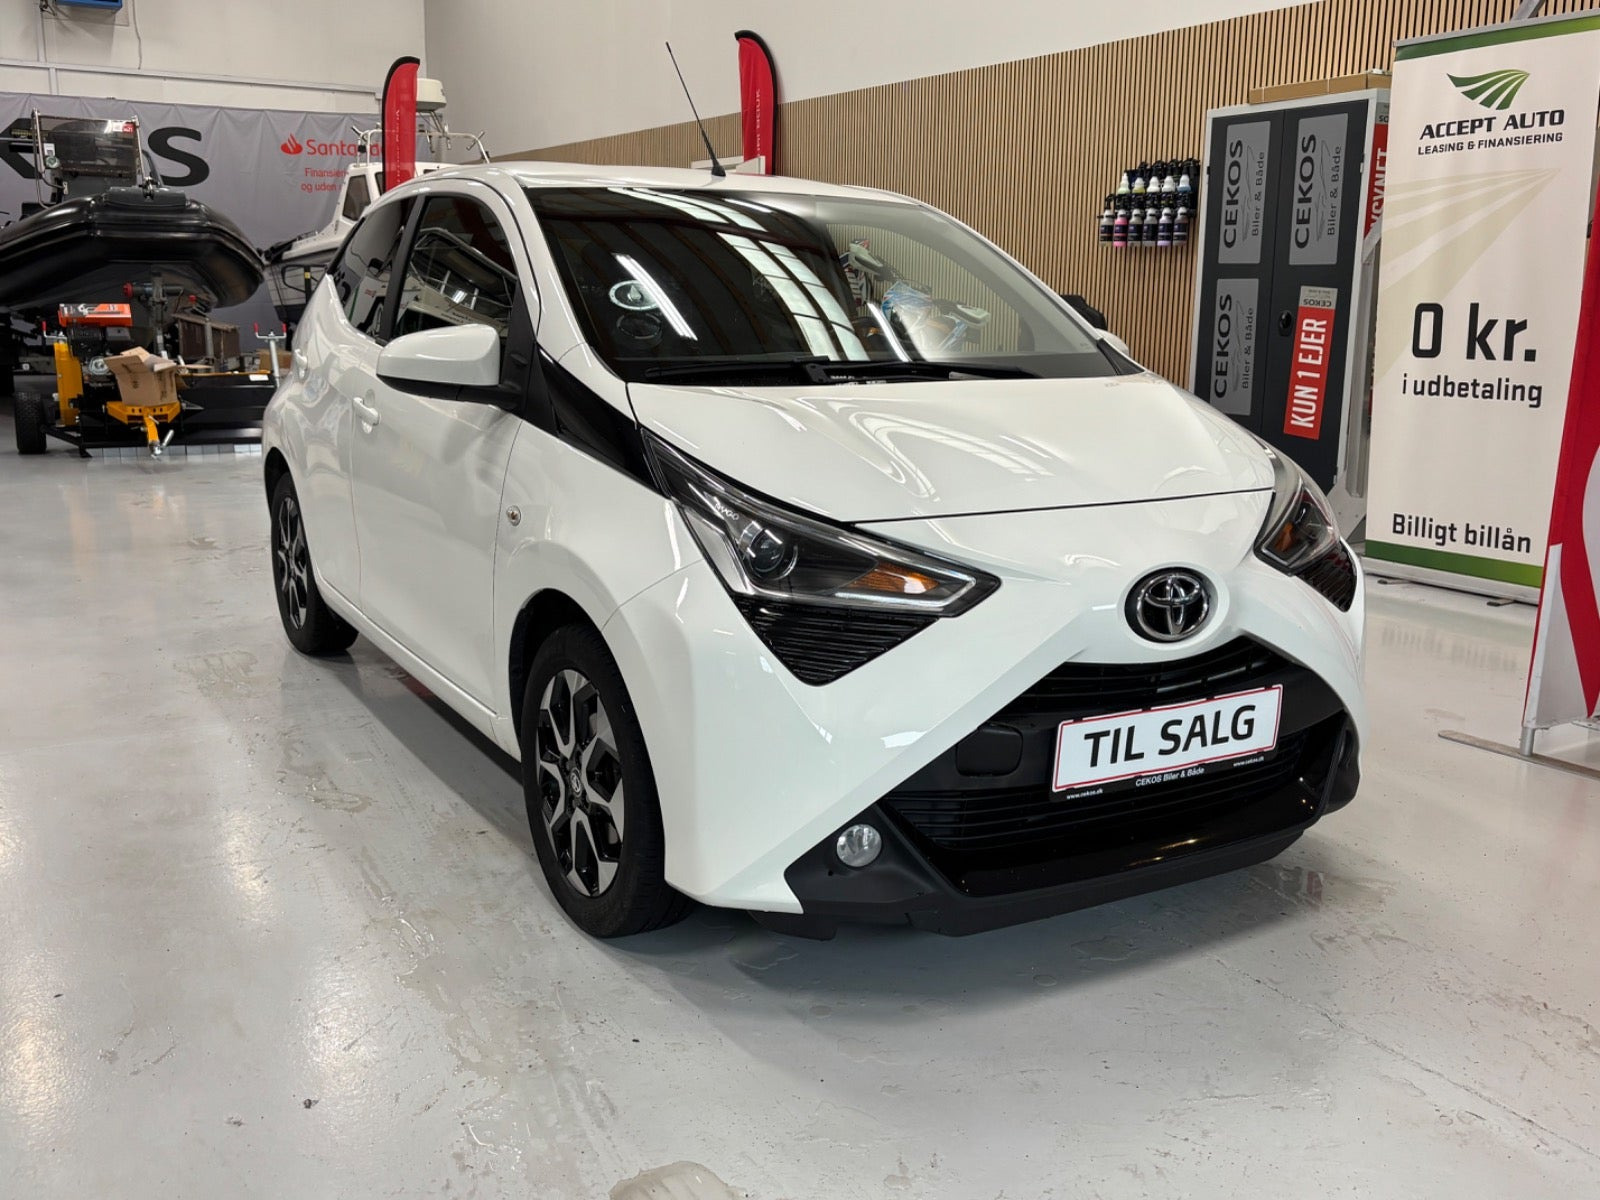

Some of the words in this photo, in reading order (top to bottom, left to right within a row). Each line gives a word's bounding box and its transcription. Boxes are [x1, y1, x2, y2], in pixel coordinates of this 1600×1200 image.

[1419, 116, 1497, 141] ACCEPT
[1503, 109, 1565, 131] AUTO
[1418, 142, 1464, 156] LEASING
[1467, 141, 1475, 150] &
[1477, 132, 1563, 149] FINANSIERING
[1255, 152, 1265, 186] Både
[1331, 146, 1341, 182] Både
[1223, 140, 1243, 249] CEKOS
[1254, 191, 1262, 201] &
[1295, 134, 1317, 249] CEKOS
[1330, 188, 1338, 199] &
[1252, 208, 1261, 237] Biler
[1327, 204, 1337, 236] Biler
[1303, 298, 1332, 308] CEKOS
[1245, 307, 1254, 341] Både
[1412, 303, 1444, 358] 0
[1466, 302, 1537, 362] kr.
[1214, 294, 1232, 399] CEKOS
[1244, 345, 1251, 355] &
[1298, 318, 1328, 366] EJER
[1242, 361, 1251, 389] Biler
[1296, 370, 1321, 379] 1
[1402, 373, 1408, 395] i
[1413, 374, 1543, 409] udbetaling
[1290, 384, 1319, 428] KUN
[1392, 513, 1457, 547] Billigt
[1464, 523, 1531, 553] billån
[1083, 725, 1145, 768] TIL
[1158, 704, 1256, 756] SALG
[1135, 774, 1162, 787] CEKOS
[1163, 772, 1180, 782] Biler
[1180, 770, 1186, 778] &
[1187, 766, 1205, 777] Både
[1066, 788, 1104, 800] www.cekos.dk
